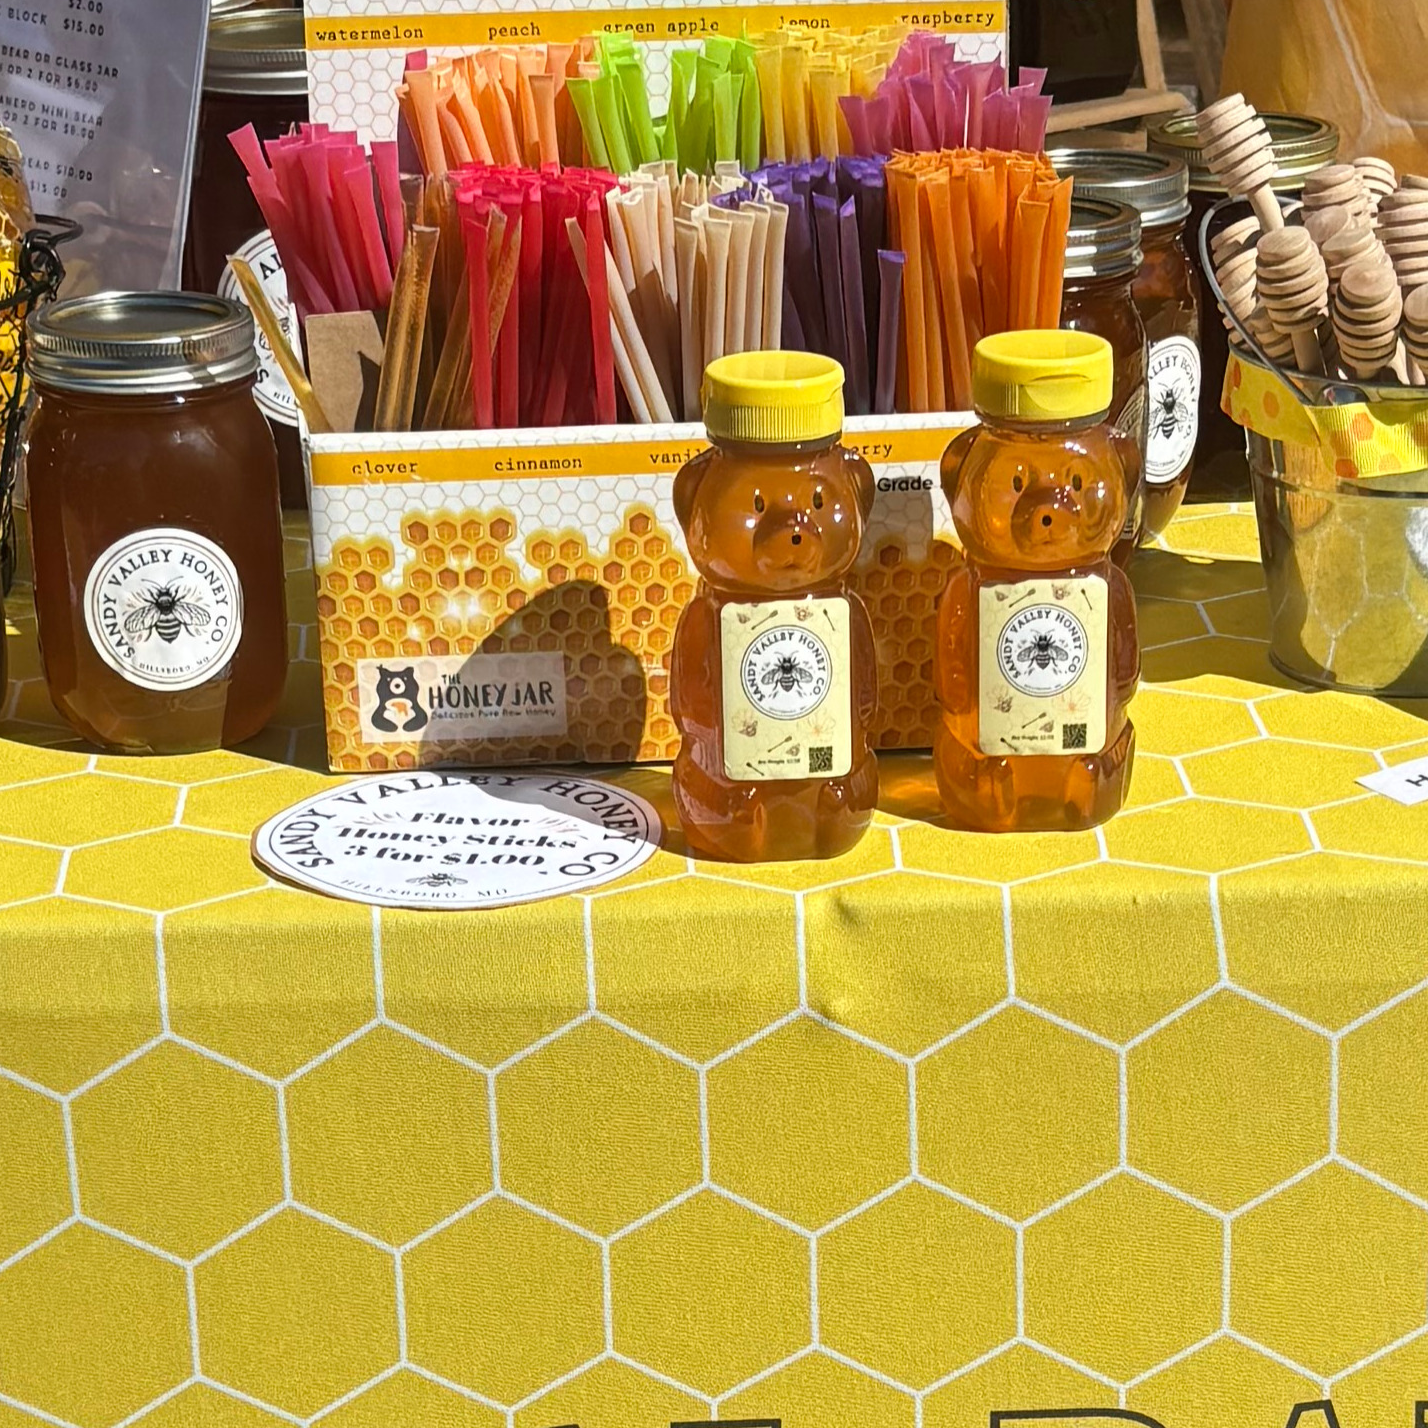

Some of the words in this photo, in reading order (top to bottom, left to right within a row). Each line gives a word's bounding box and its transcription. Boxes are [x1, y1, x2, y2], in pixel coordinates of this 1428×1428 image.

[8, 7, 48, 26] BLOCK
[63, 18, 105, 37] $15.00
[667, 18, 719, 36] apple
[900, 10, 995, 28] raspberry
[316, 26, 424, 43] watermelon
[488, 22, 541, 40] peach
[56, 54, 92, 74] GLASS
[38, 70, 60, 85] FOR
[351, 459, 419, 476] clover
[493, 455, 583, 473] cinnamon
[876, 476, 933, 492] Grade
[108, 549, 172, 587] VALLEY
[180, 552, 228, 606] HONEY
[103, 593, 135, 659] SANDY
[1010, 610, 1052, 633] VALLEY
[1055, 613, 1082, 650] HONEY
[753, 632, 794, 656] VALLEY
[798, 634, 826, 672] HONEY
[1004, 637, 1022, 679] SANDY
[441, 673, 461, 685] THE
[748, 660, 766, 702] SANDY
[428, 684, 506, 709] HONEY
[279, 808, 337, 869] SANDY
[337, 774, 525, 805] VALLEY
[542, 779, 647, 844] HONEY
[410, 812, 531, 827] Flavor
[337, 827, 457, 848] Honey
[461, 833, 578, 850] Sticks
[344, 844, 369, 857] 3
[375, 846, 434, 863] for
[440, 850, 546, 867] $1.00
